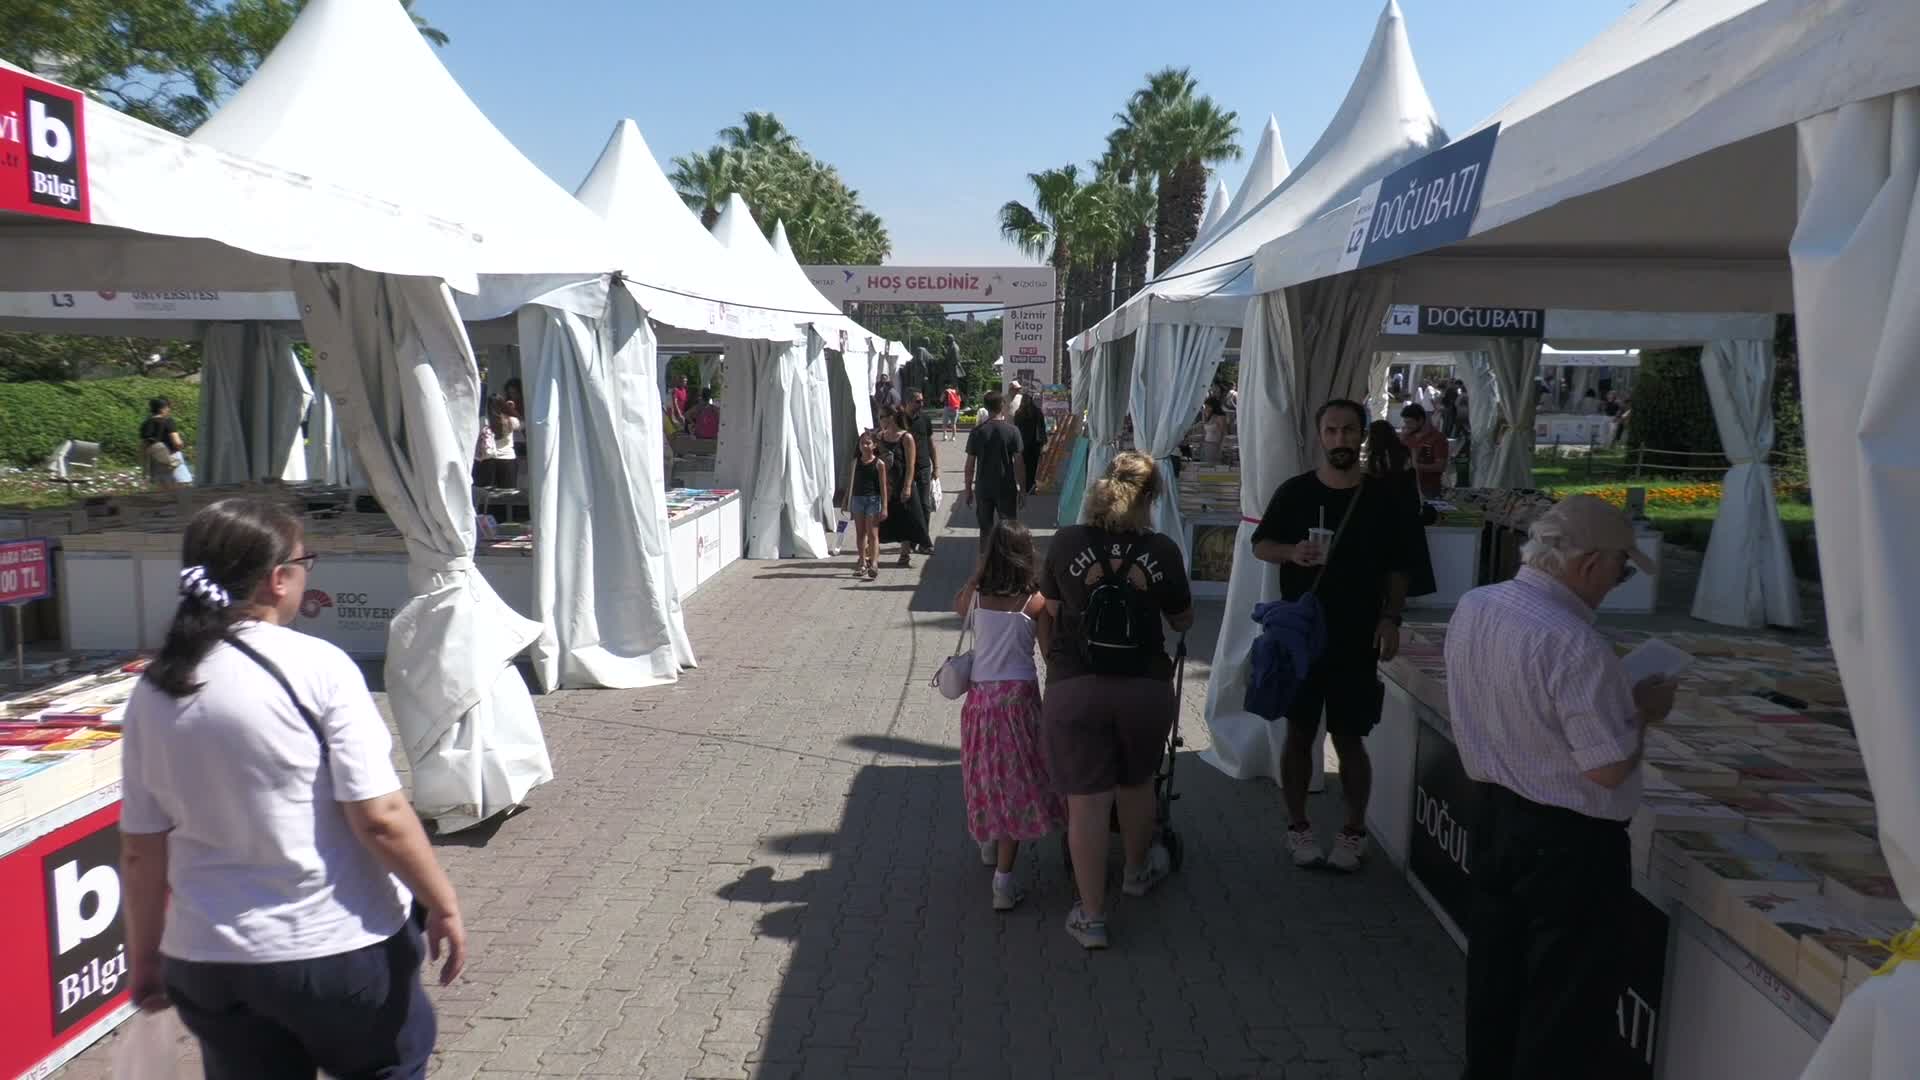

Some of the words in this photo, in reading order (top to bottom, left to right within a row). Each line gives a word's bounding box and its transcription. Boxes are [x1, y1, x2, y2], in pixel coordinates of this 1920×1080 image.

[29, 99, 73, 162] b
[32, 170, 78, 206] Bilgi
[1371, 161, 1480, 244] DOĞUBATI
[1346, 228, 1364, 254] L2
[867, 275, 902, 293] HOŞ
[906, 272, 979, 290] GELDİNİZ
[51, 293, 75, 308] L3
[1014, 321, 1043, 333] Kitap
[1393, 314, 1412, 326] L4
[1428, 306, 1537, 329] DOĞUBATI
[1014, 332, 1043, 341] Fuarı
[1069, 547, 1097, 578] CHI
[1111, 543, 1122, 557] &
[21, 567, 41, 589] TL
[336, 592, 368, 606] KOÇ
[54, 859, 122, 956] b
[58, 943, 128, 1014] Bilgi
